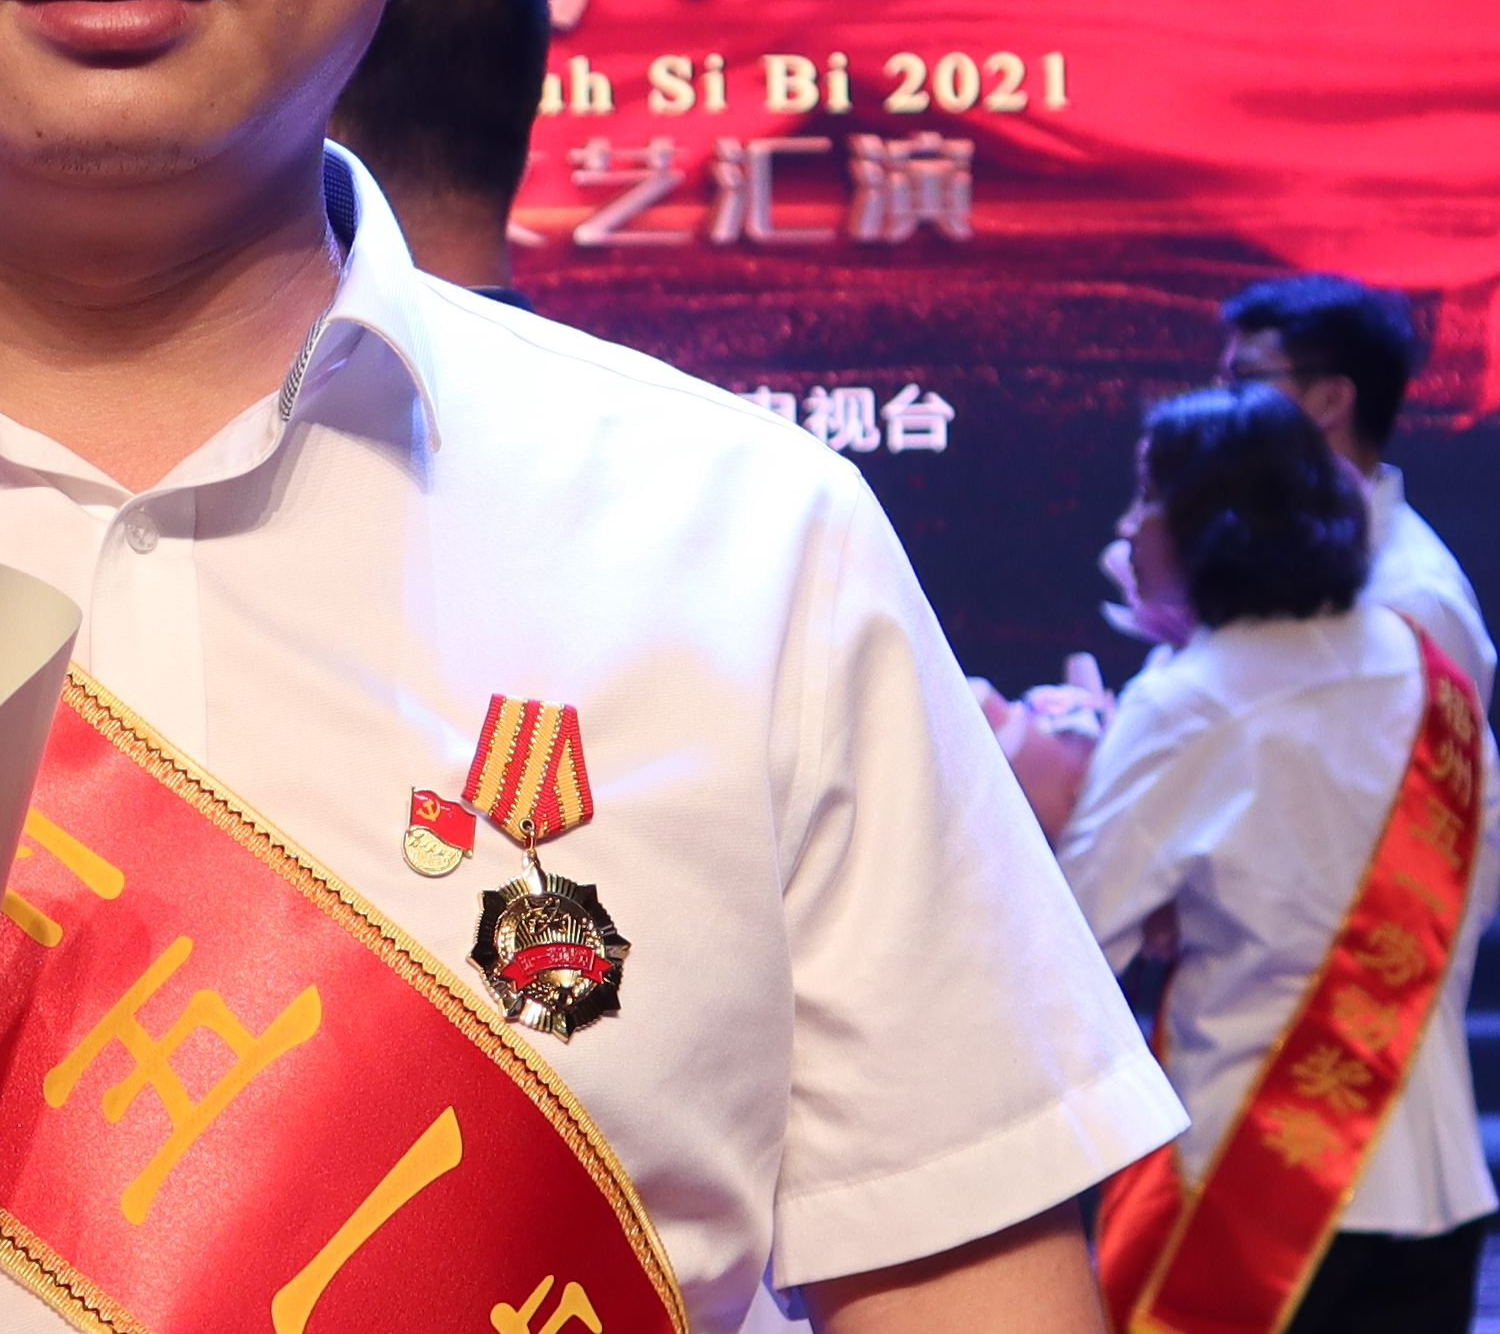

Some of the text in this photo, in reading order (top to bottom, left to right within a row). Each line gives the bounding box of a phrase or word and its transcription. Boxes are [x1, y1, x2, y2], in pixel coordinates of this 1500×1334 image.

[647, 52, 728, 115] Si
[764, 51, 853, 114] Bi
[883, 50, 1069, 115] 2021
[507, 132, 974, 247] 艺汇演
